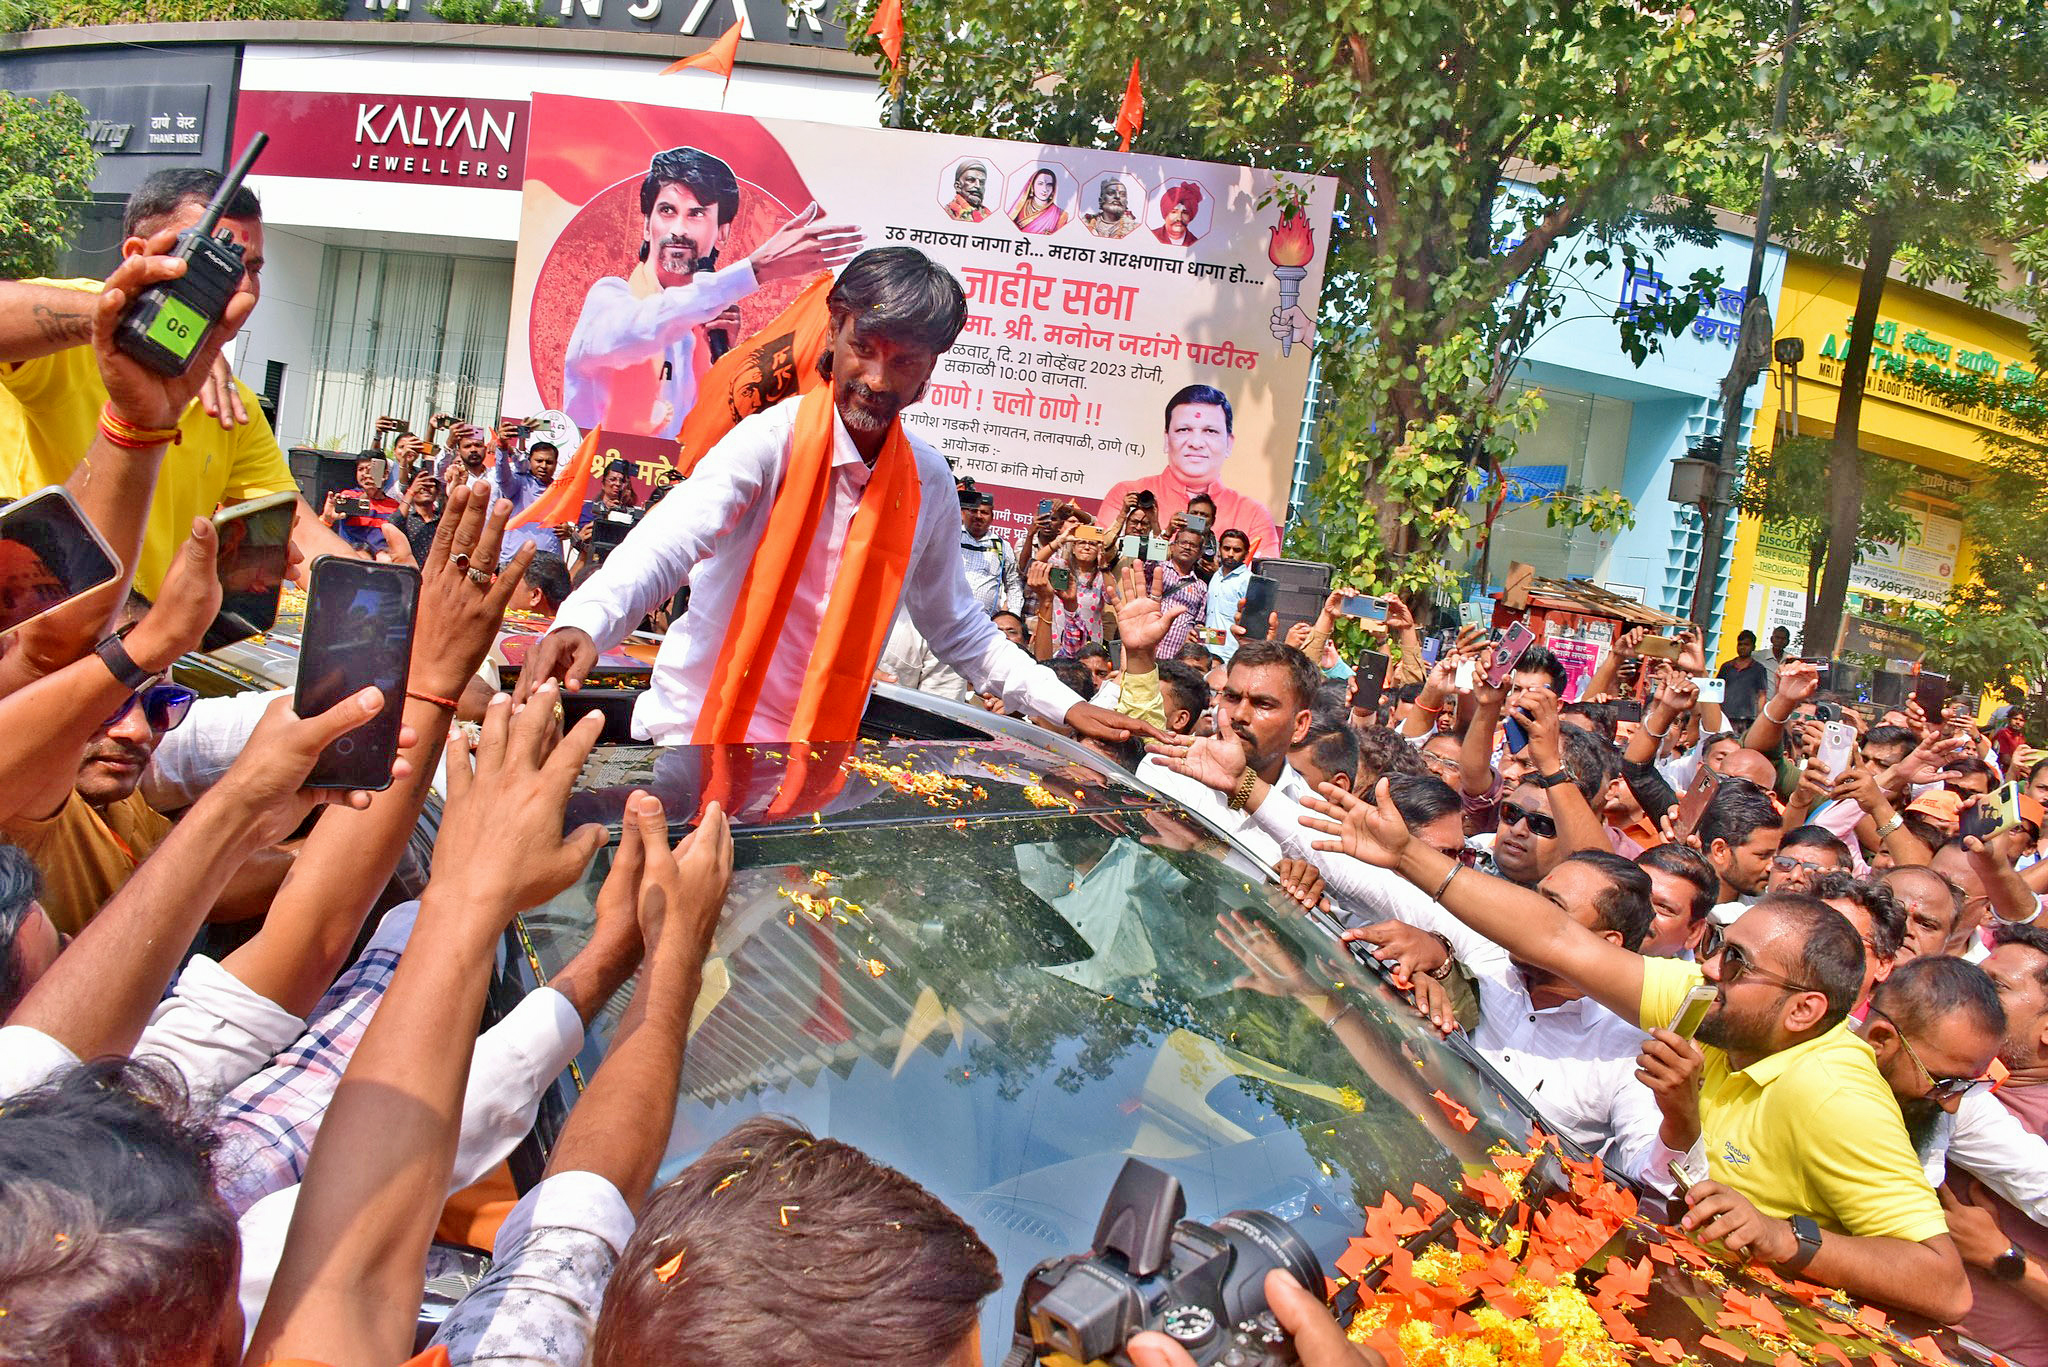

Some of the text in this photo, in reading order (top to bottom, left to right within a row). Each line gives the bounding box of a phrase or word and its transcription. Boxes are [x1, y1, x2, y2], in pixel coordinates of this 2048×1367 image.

[150, 112, 197, 129] ठाणे वेस्ट
[355, 104, 516, 152] KALYAN
[149, 133, 199, 144] THANE WEST
[352, 155, 508, 179] JEWELLERS
[885, 226, 907, 240] उठ
[972, 235, 1012, 253] जागा
[1048, 244, 1096, 263] मराठा
[1100, 250, 1184, 274] आरक्षणाचा
[1188, 261, 1226, 280] धागा
[961, 262, 1139, 322] जाहीर सभा
[166, 317, 190, 338] 06
[1003, 314, 1037, 343] श्री.
[1043, 322, 1114, 352] मनोज
[1118, 332, 1182, 360] जरांगे
[1186, 341, 1259, 371] पाटील
[944, 359, 1087, 390] सकाळी 10:00 वाजता.
[1018, 351, 1032, 366] 21
[1036, 351, 1087, 372] नोव्हेंबर
[1090, 361, 1127, 378] 2023
[1130, 363, 1164, 385] रोजी,
[1878, 379, 1901, 396] BLOOD
[931, 380, 972, 410] ठाणे
[993, 387, 1036, 417] चलो
[1038, 393, 1081, 423] ठाणे
[910, 412, 940, 428] गणेश
[942, 419, 980, 433] गडकरी
[1098, 437, 1122, 453] ठाणे
[941, 437, 991, 455] आयोजक
[967, 458, 997, 473] मराठा
[1060, 470, 1084, 485] ठाणे
[1760, 561, 1805, 577] THROUGHOUT
[1725, 1141, 1751, 1162] Reebok
